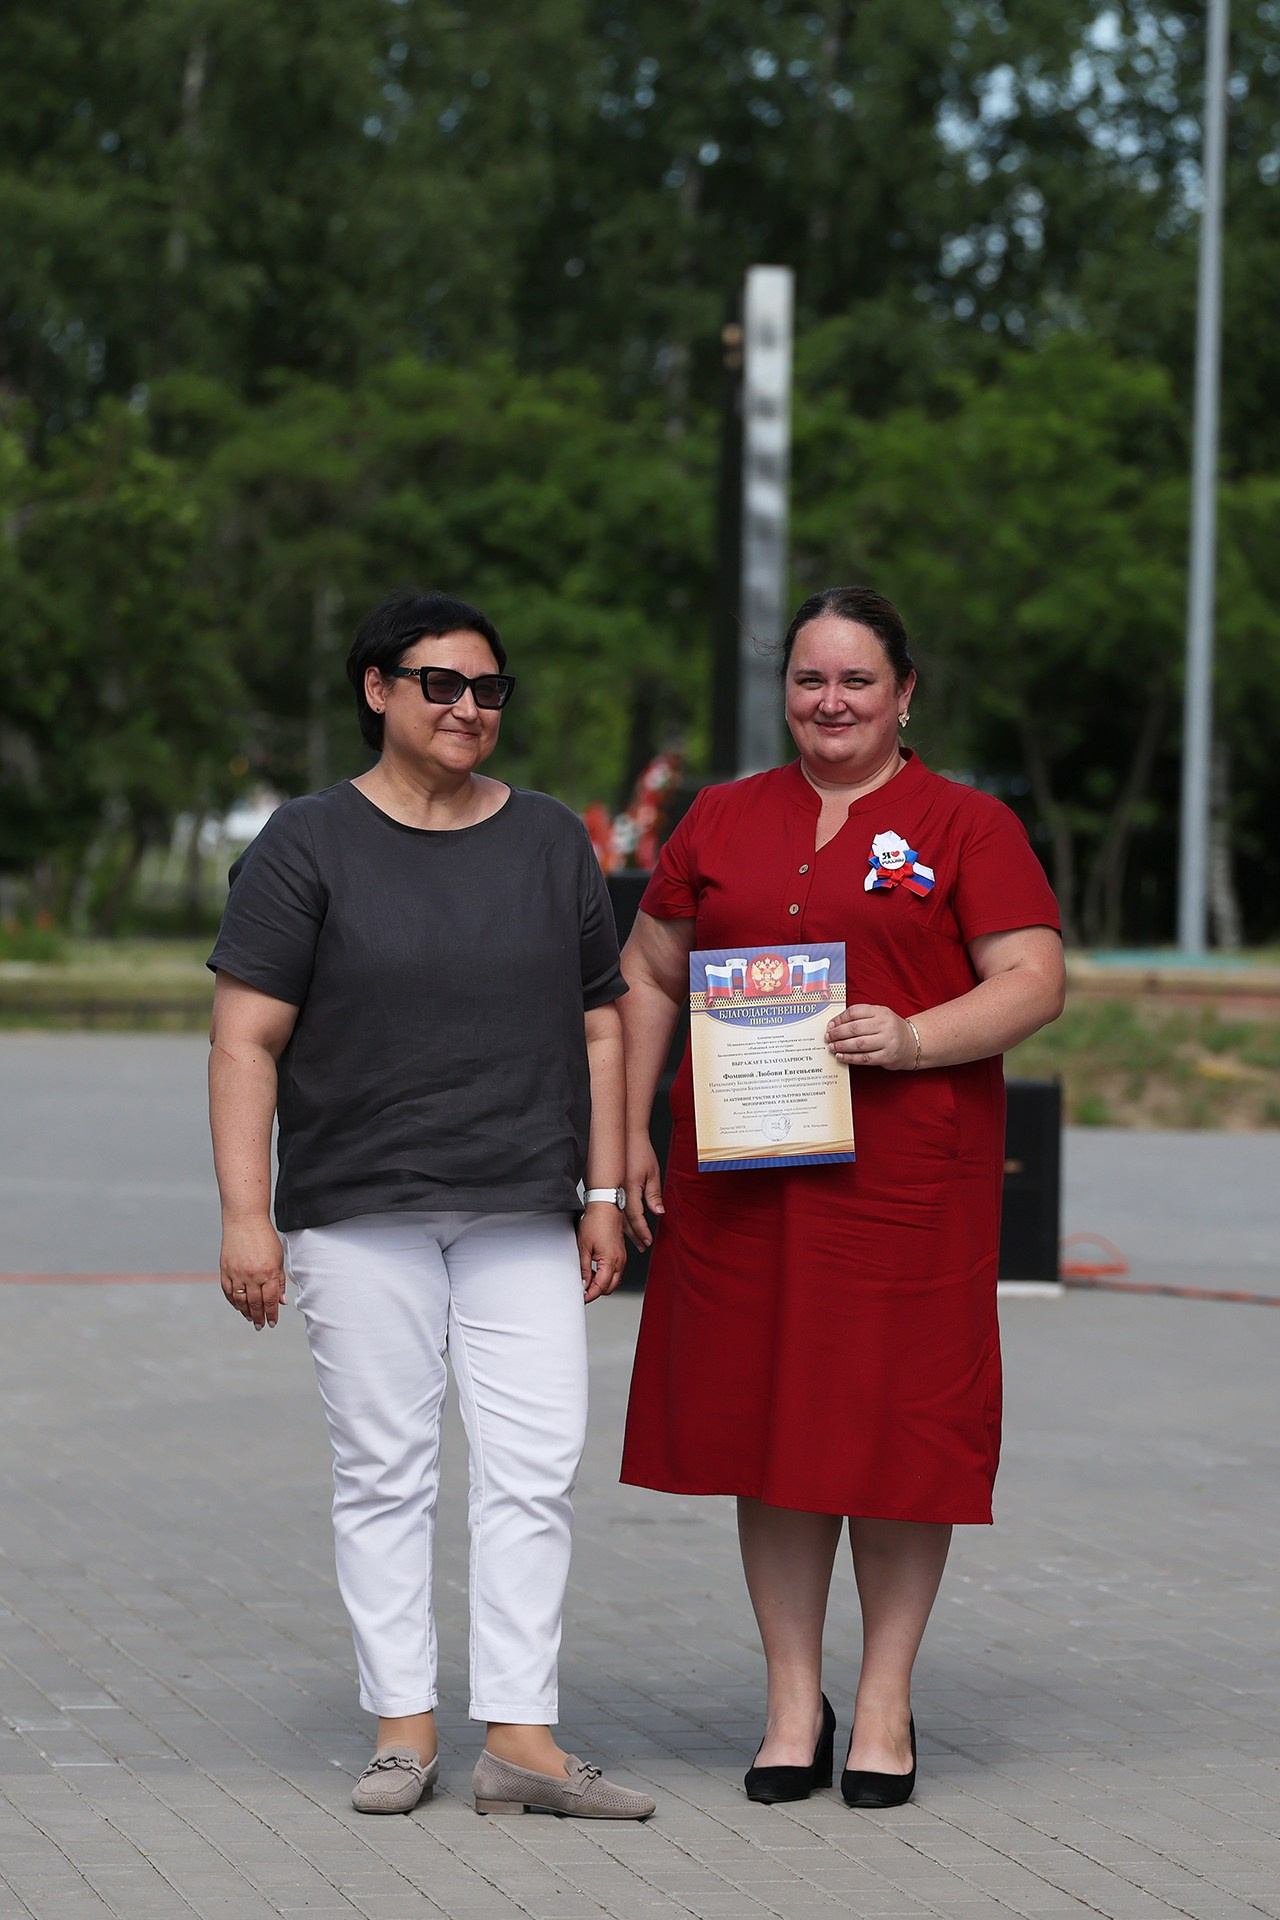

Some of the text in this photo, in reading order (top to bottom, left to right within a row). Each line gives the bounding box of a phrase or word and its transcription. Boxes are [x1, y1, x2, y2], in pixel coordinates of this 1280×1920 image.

[882, 852, 891, 860] Я
[719, 1004, 817, 1018] БЛАГОДАРСТВЕННОЕ
[750, 1017, 783, 1025] ПИСЬМО
[784, 1067, 823, 1075] Евгеньевне
